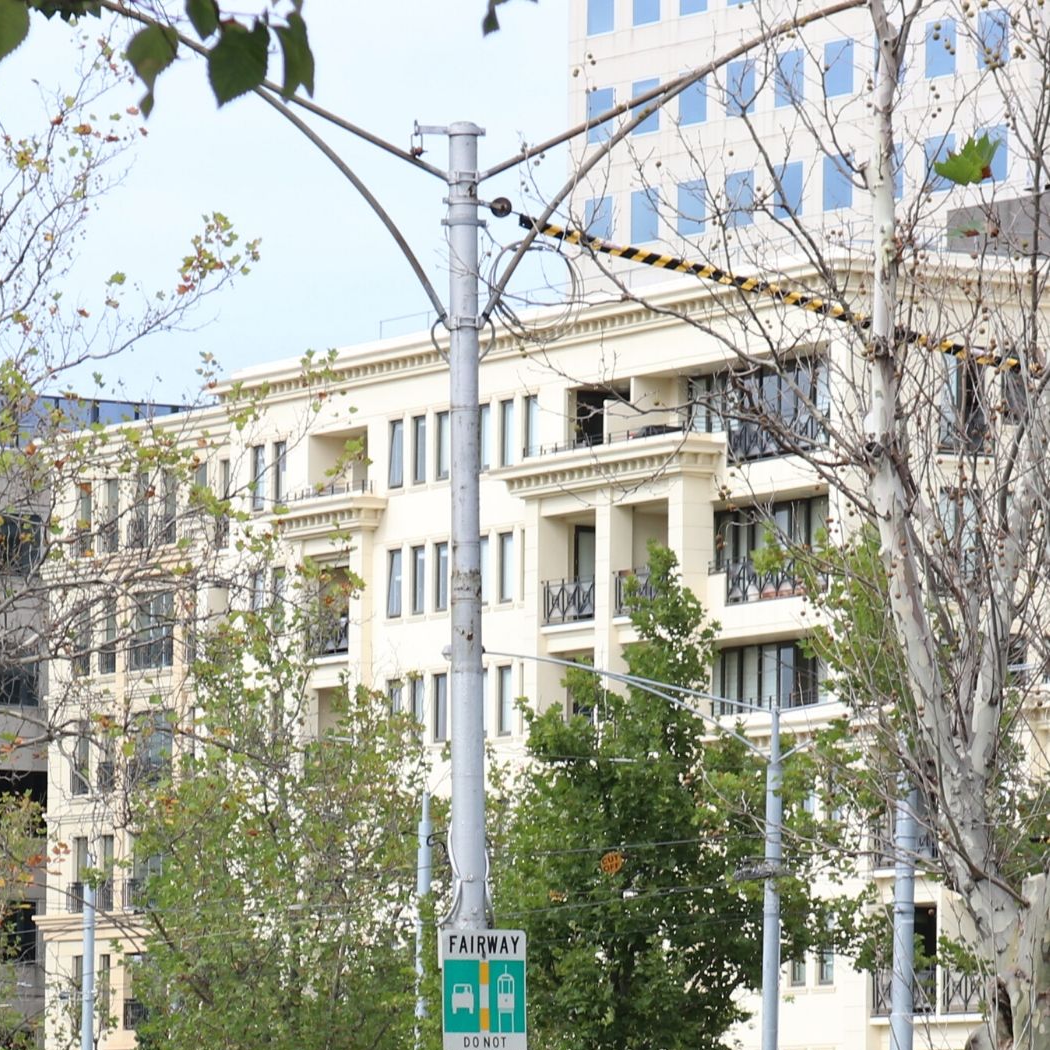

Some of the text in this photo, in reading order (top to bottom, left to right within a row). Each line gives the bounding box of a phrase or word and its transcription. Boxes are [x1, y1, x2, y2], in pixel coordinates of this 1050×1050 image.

[449, 935, 520, 954] FAIRWAY
[463, 1036, 507, 1048] DO NOT
